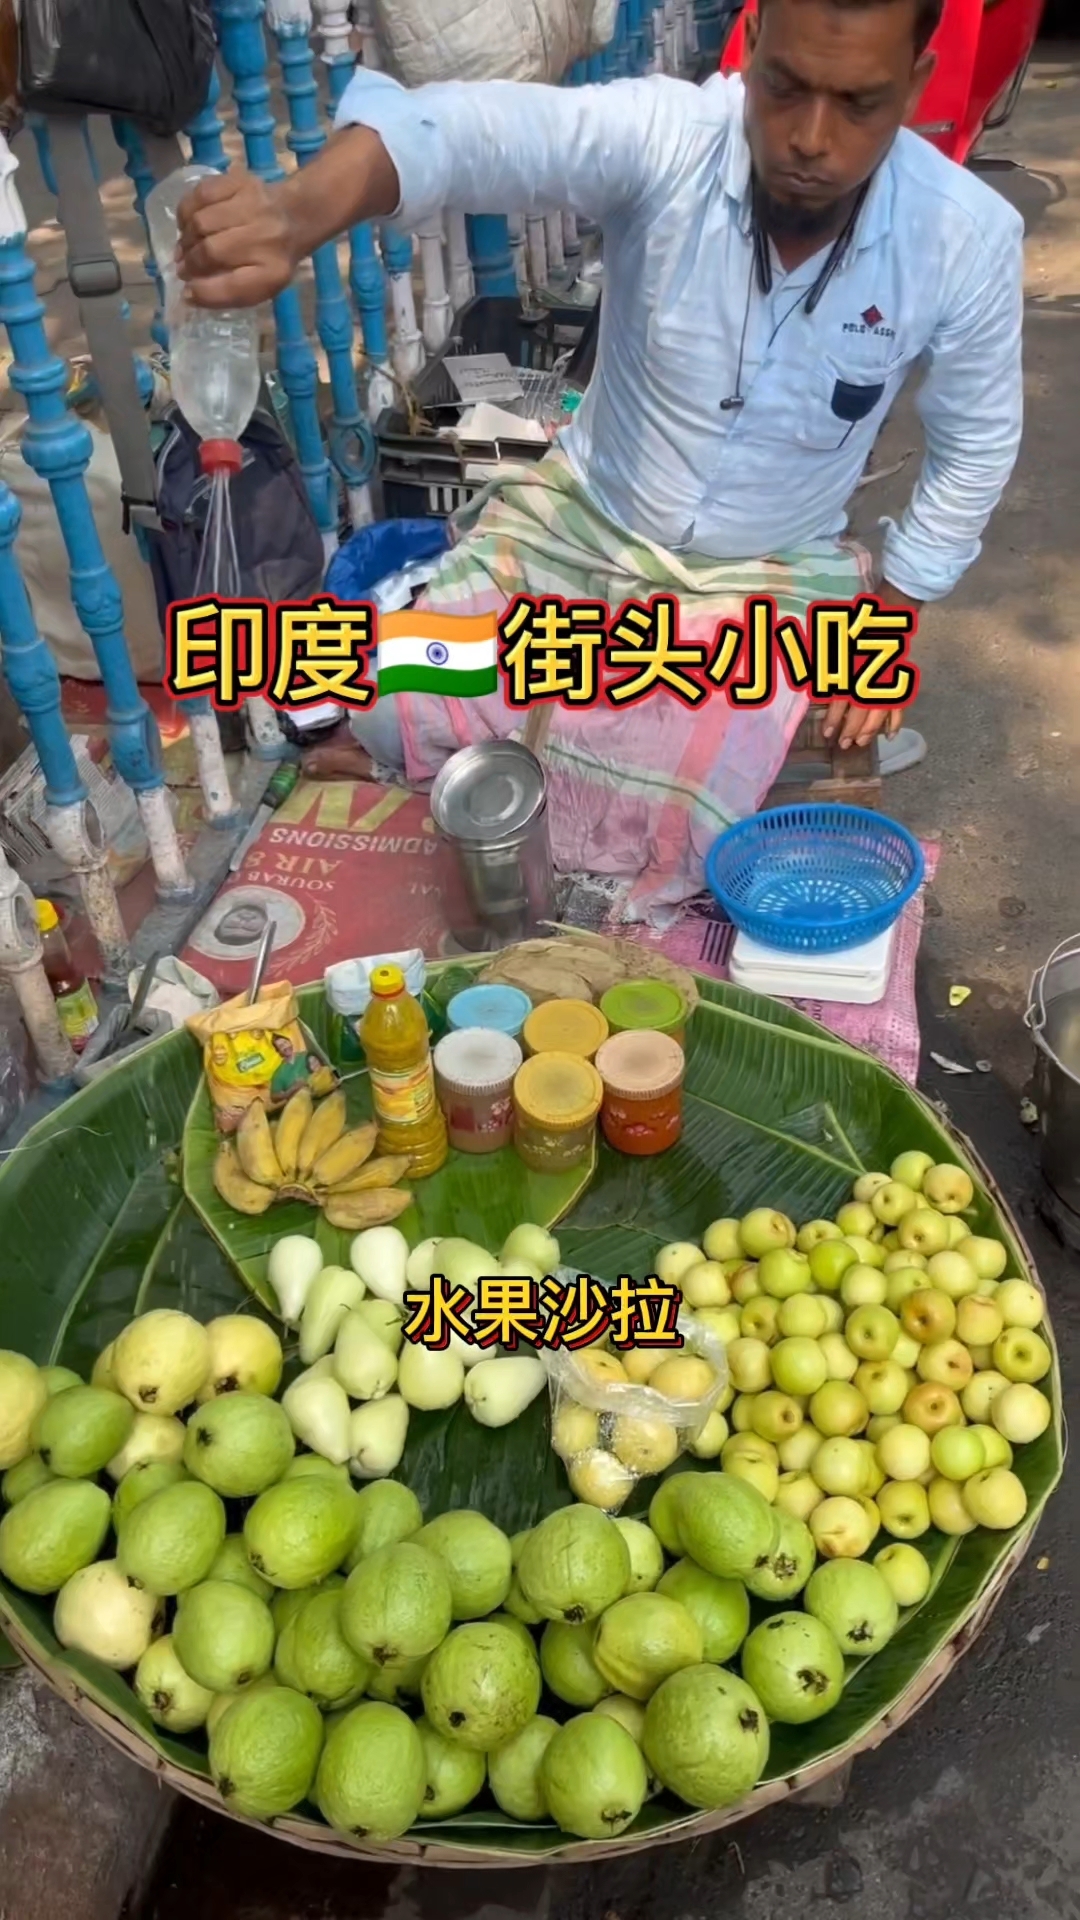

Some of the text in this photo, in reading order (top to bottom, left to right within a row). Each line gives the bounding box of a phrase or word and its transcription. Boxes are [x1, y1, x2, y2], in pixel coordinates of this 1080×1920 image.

[268, 827, 438, 856] ADMISSIONS
[274, 851, 344, 876] AIR
[247, 870, 337, 891] SOURAB
